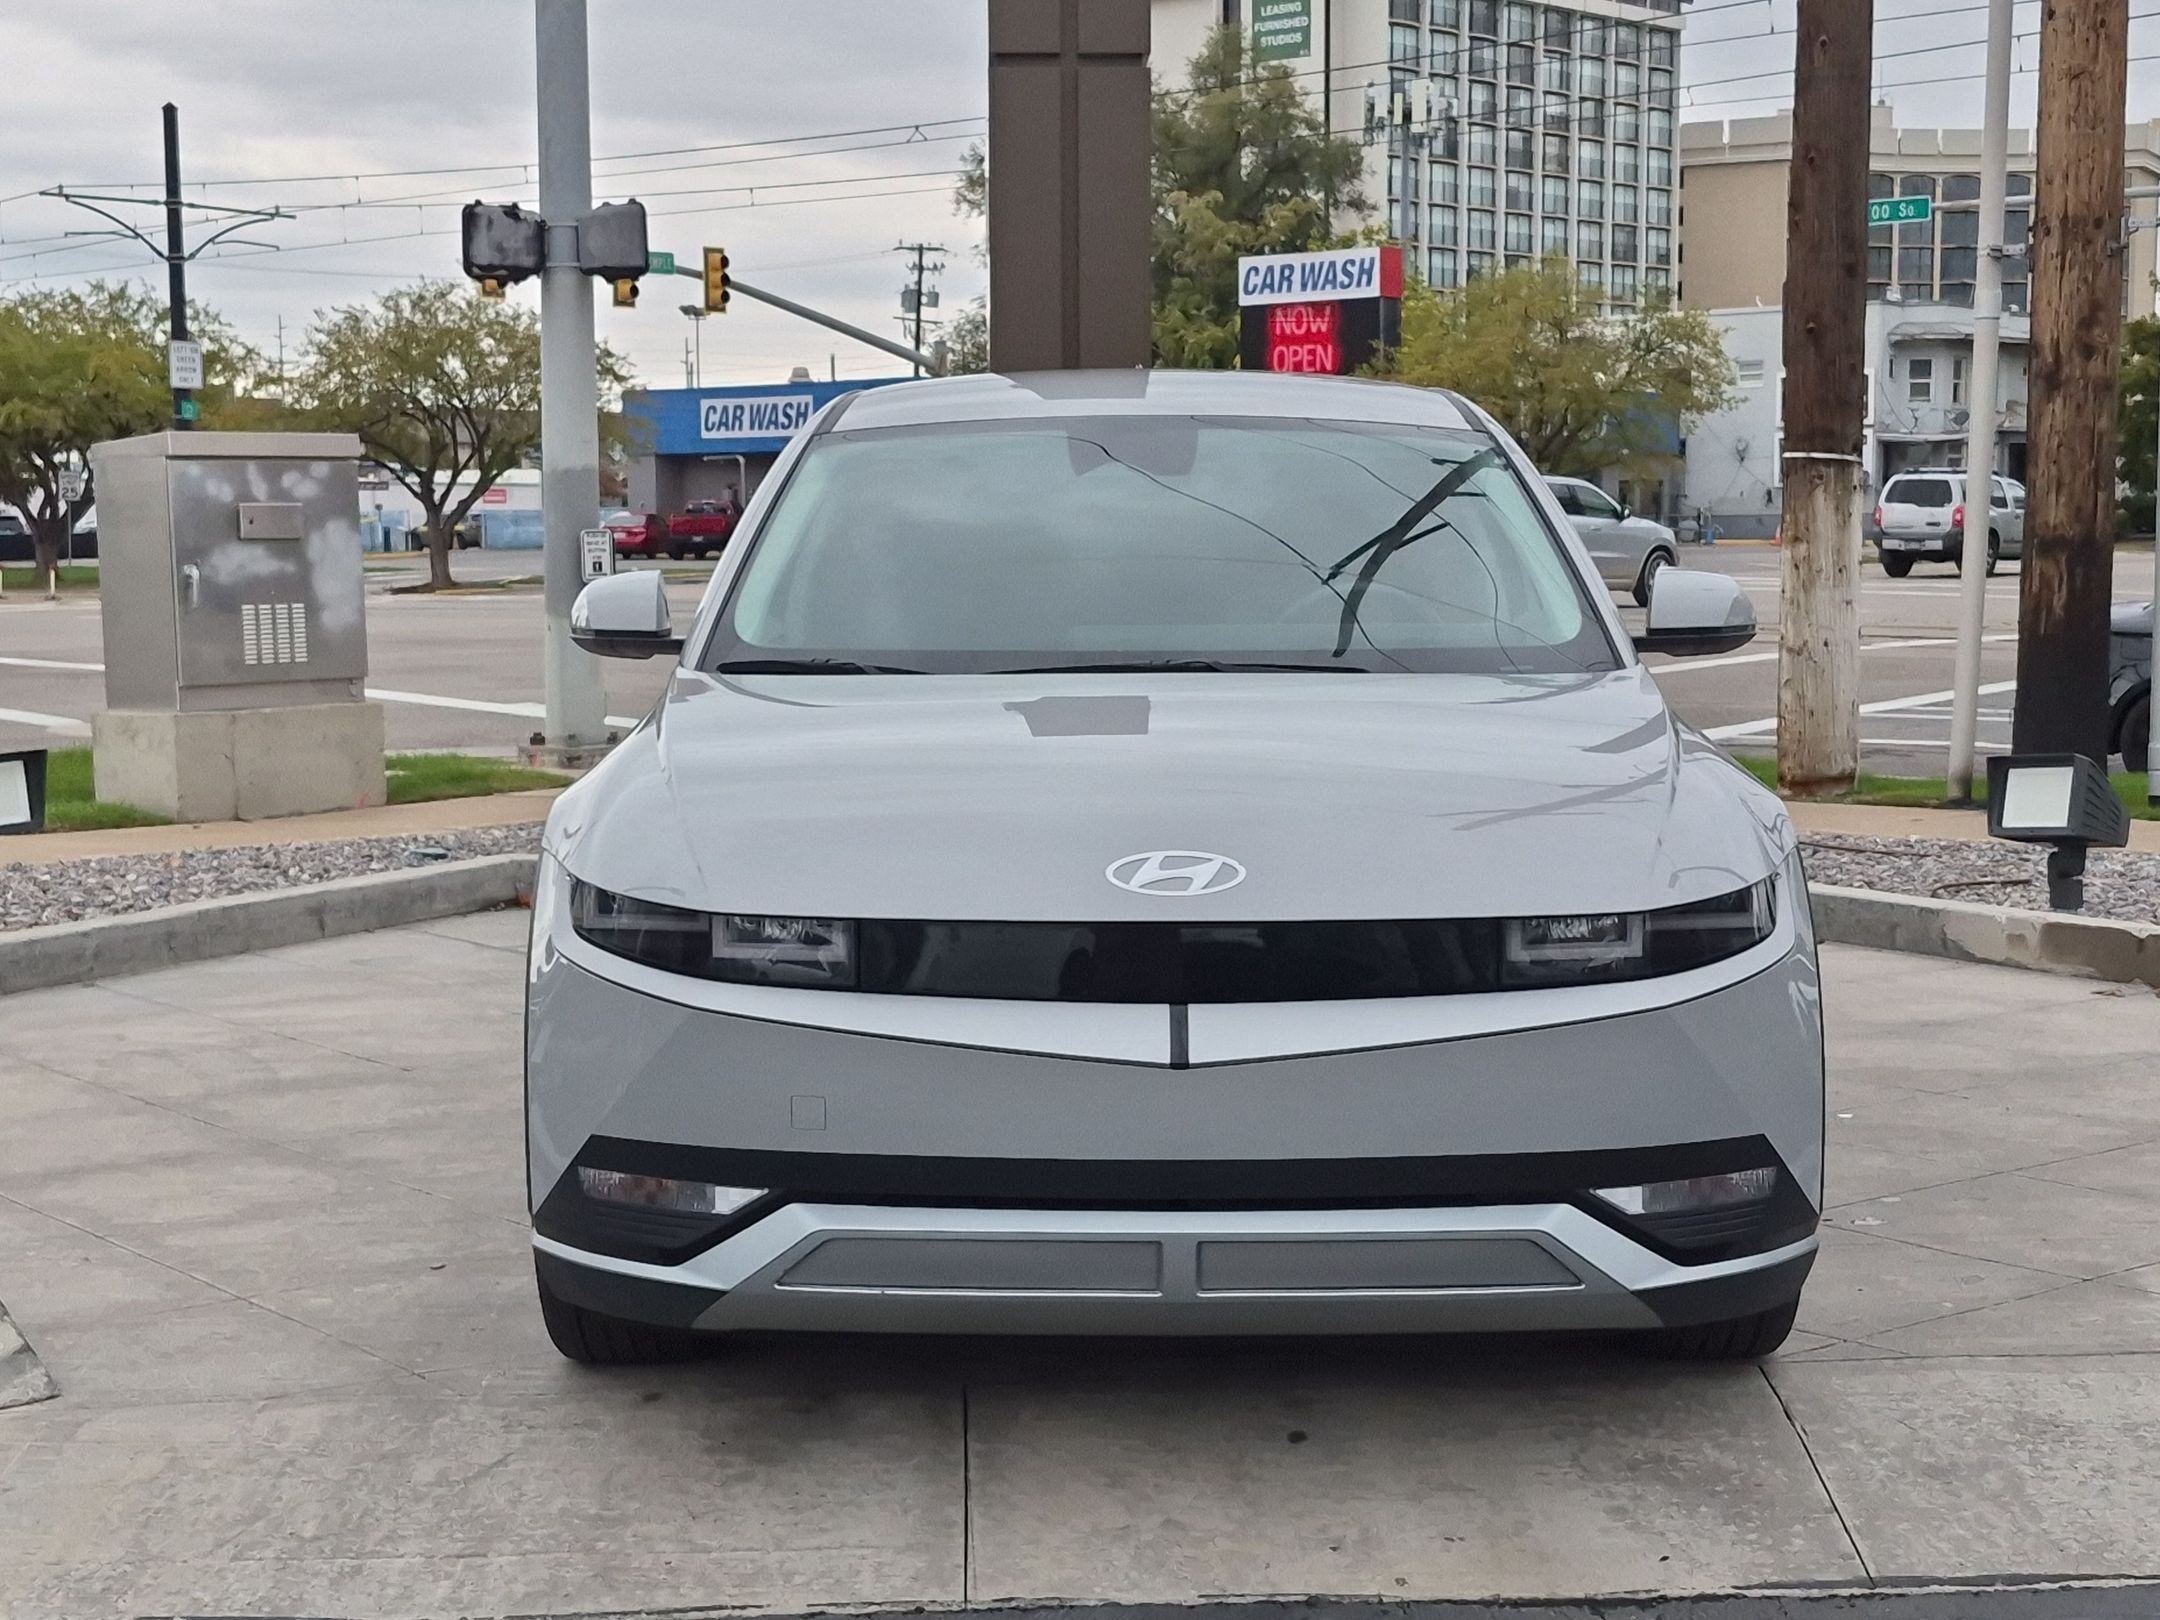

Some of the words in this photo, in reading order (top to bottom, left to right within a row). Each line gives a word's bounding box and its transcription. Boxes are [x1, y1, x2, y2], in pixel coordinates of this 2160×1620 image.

[1261, 2, 1302, 16] LEASING
[1254, 16, 1309, 32] FURNISHED
[1260, 32, 1303, 47] STUDIOS
[1871, 204, 1890, 220] 00
[649, 255, 673, 271] MPLE
[1243, 263, 1295, 296] CAR
[1300, 256, 1376, 292] WASH
[1274, 305, 1331, 335] NOW
[1273, 344, 1333, 373] OPEN
[704, 404, 745, 432] CAR
[748, 401, 810, 431] WASH
[62, 487, 78, 498] 25
